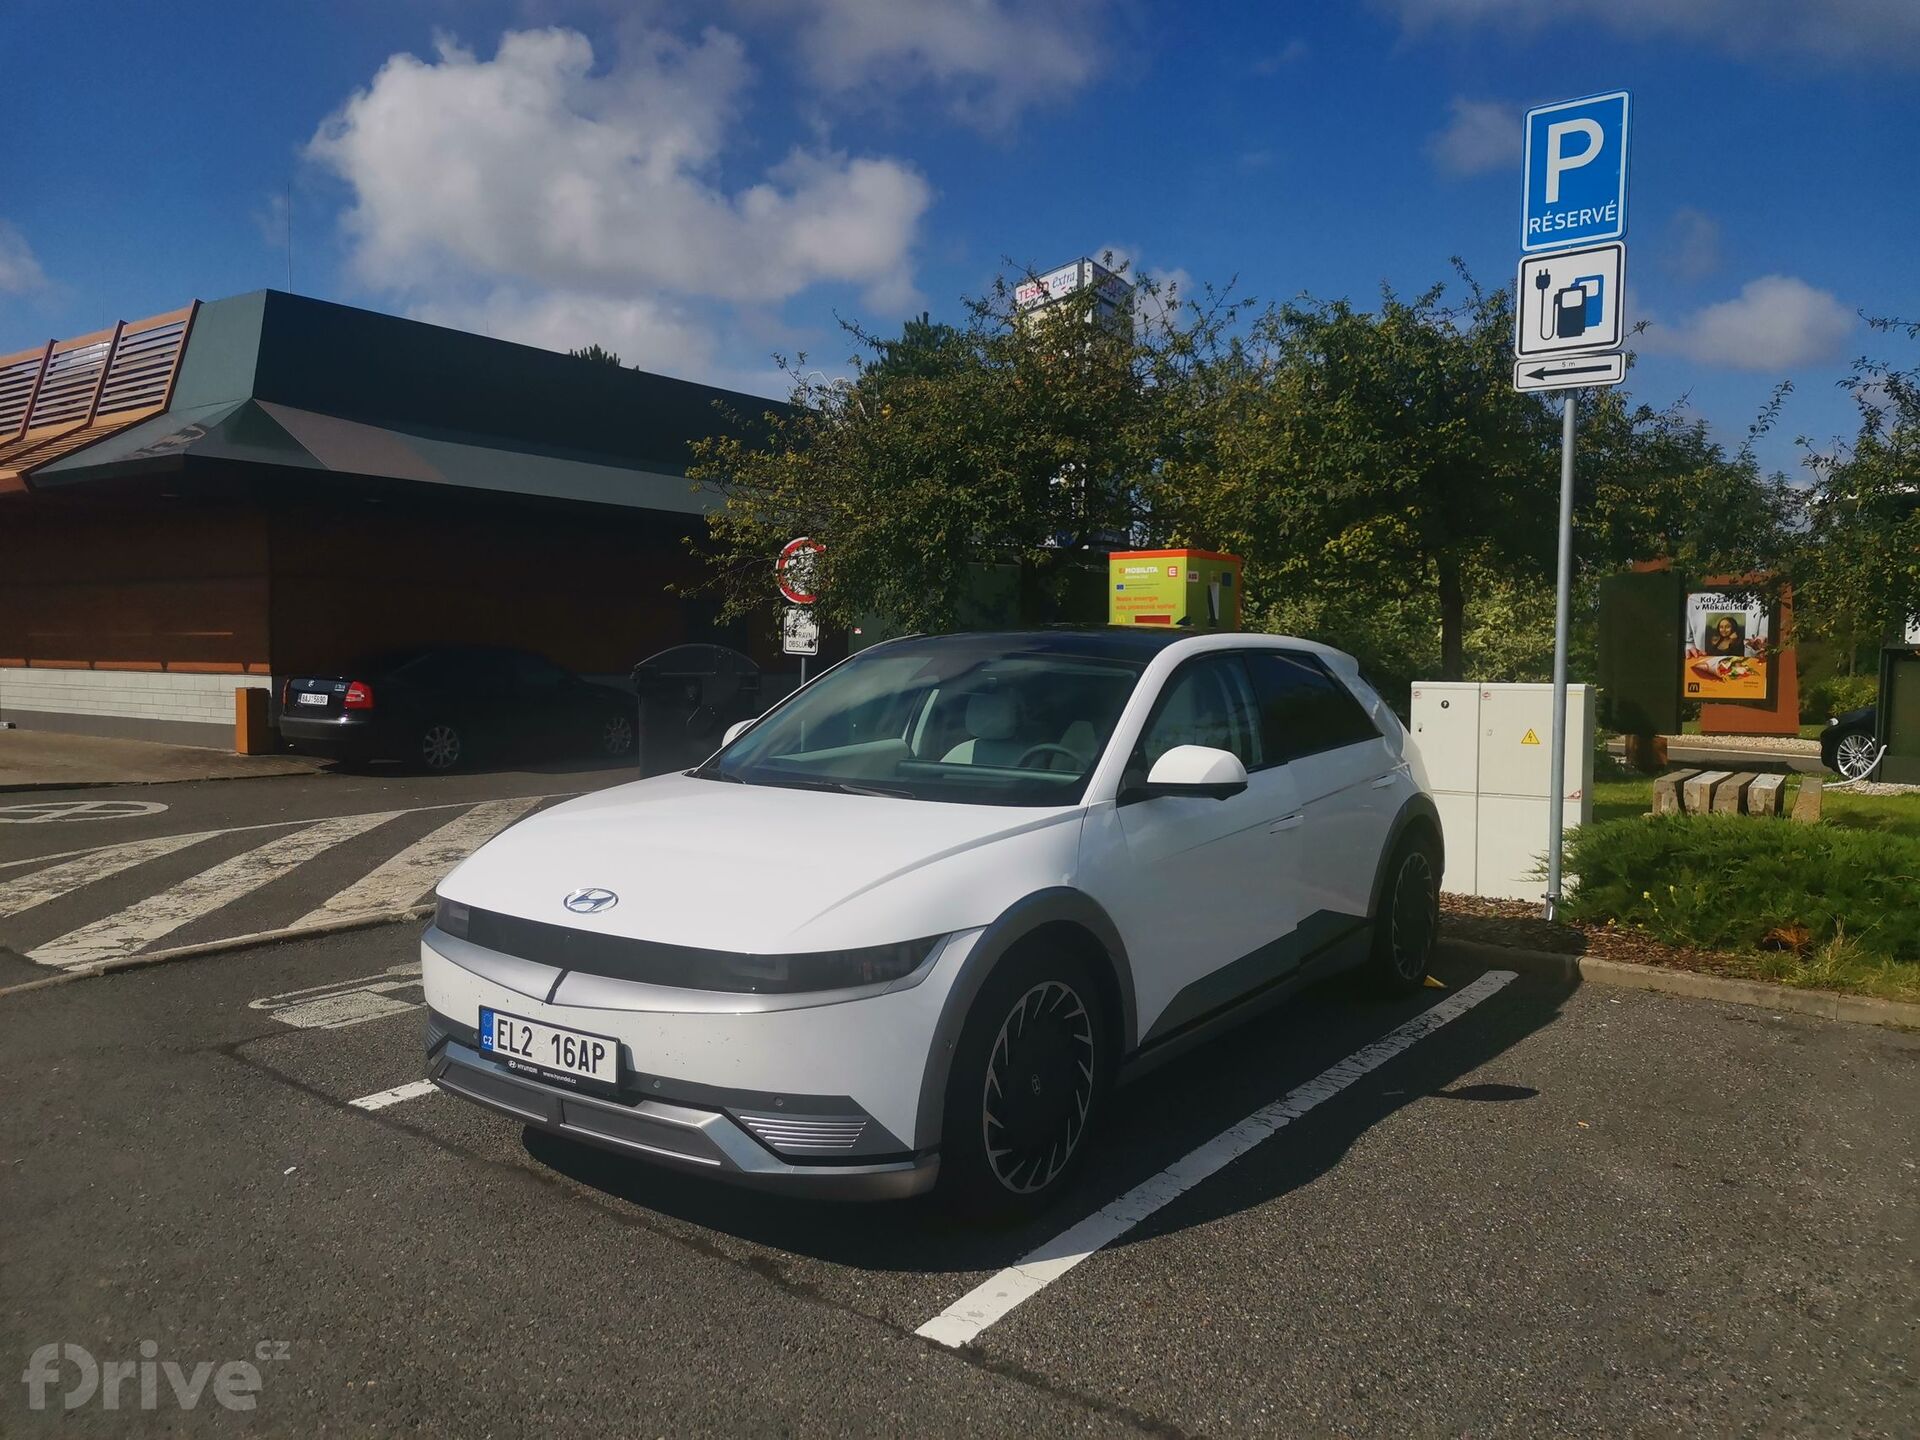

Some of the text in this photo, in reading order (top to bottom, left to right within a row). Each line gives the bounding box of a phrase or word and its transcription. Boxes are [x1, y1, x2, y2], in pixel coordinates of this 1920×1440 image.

[1545, 118, 1604, 204] P
[1529, 200, 1617, 235] RÉSERVÉ
[1052, 270, 1076, 288] extra
[482, 1035, 493, 1046] CZ
[497, 1018, 606, 1074] EL2 16AP
